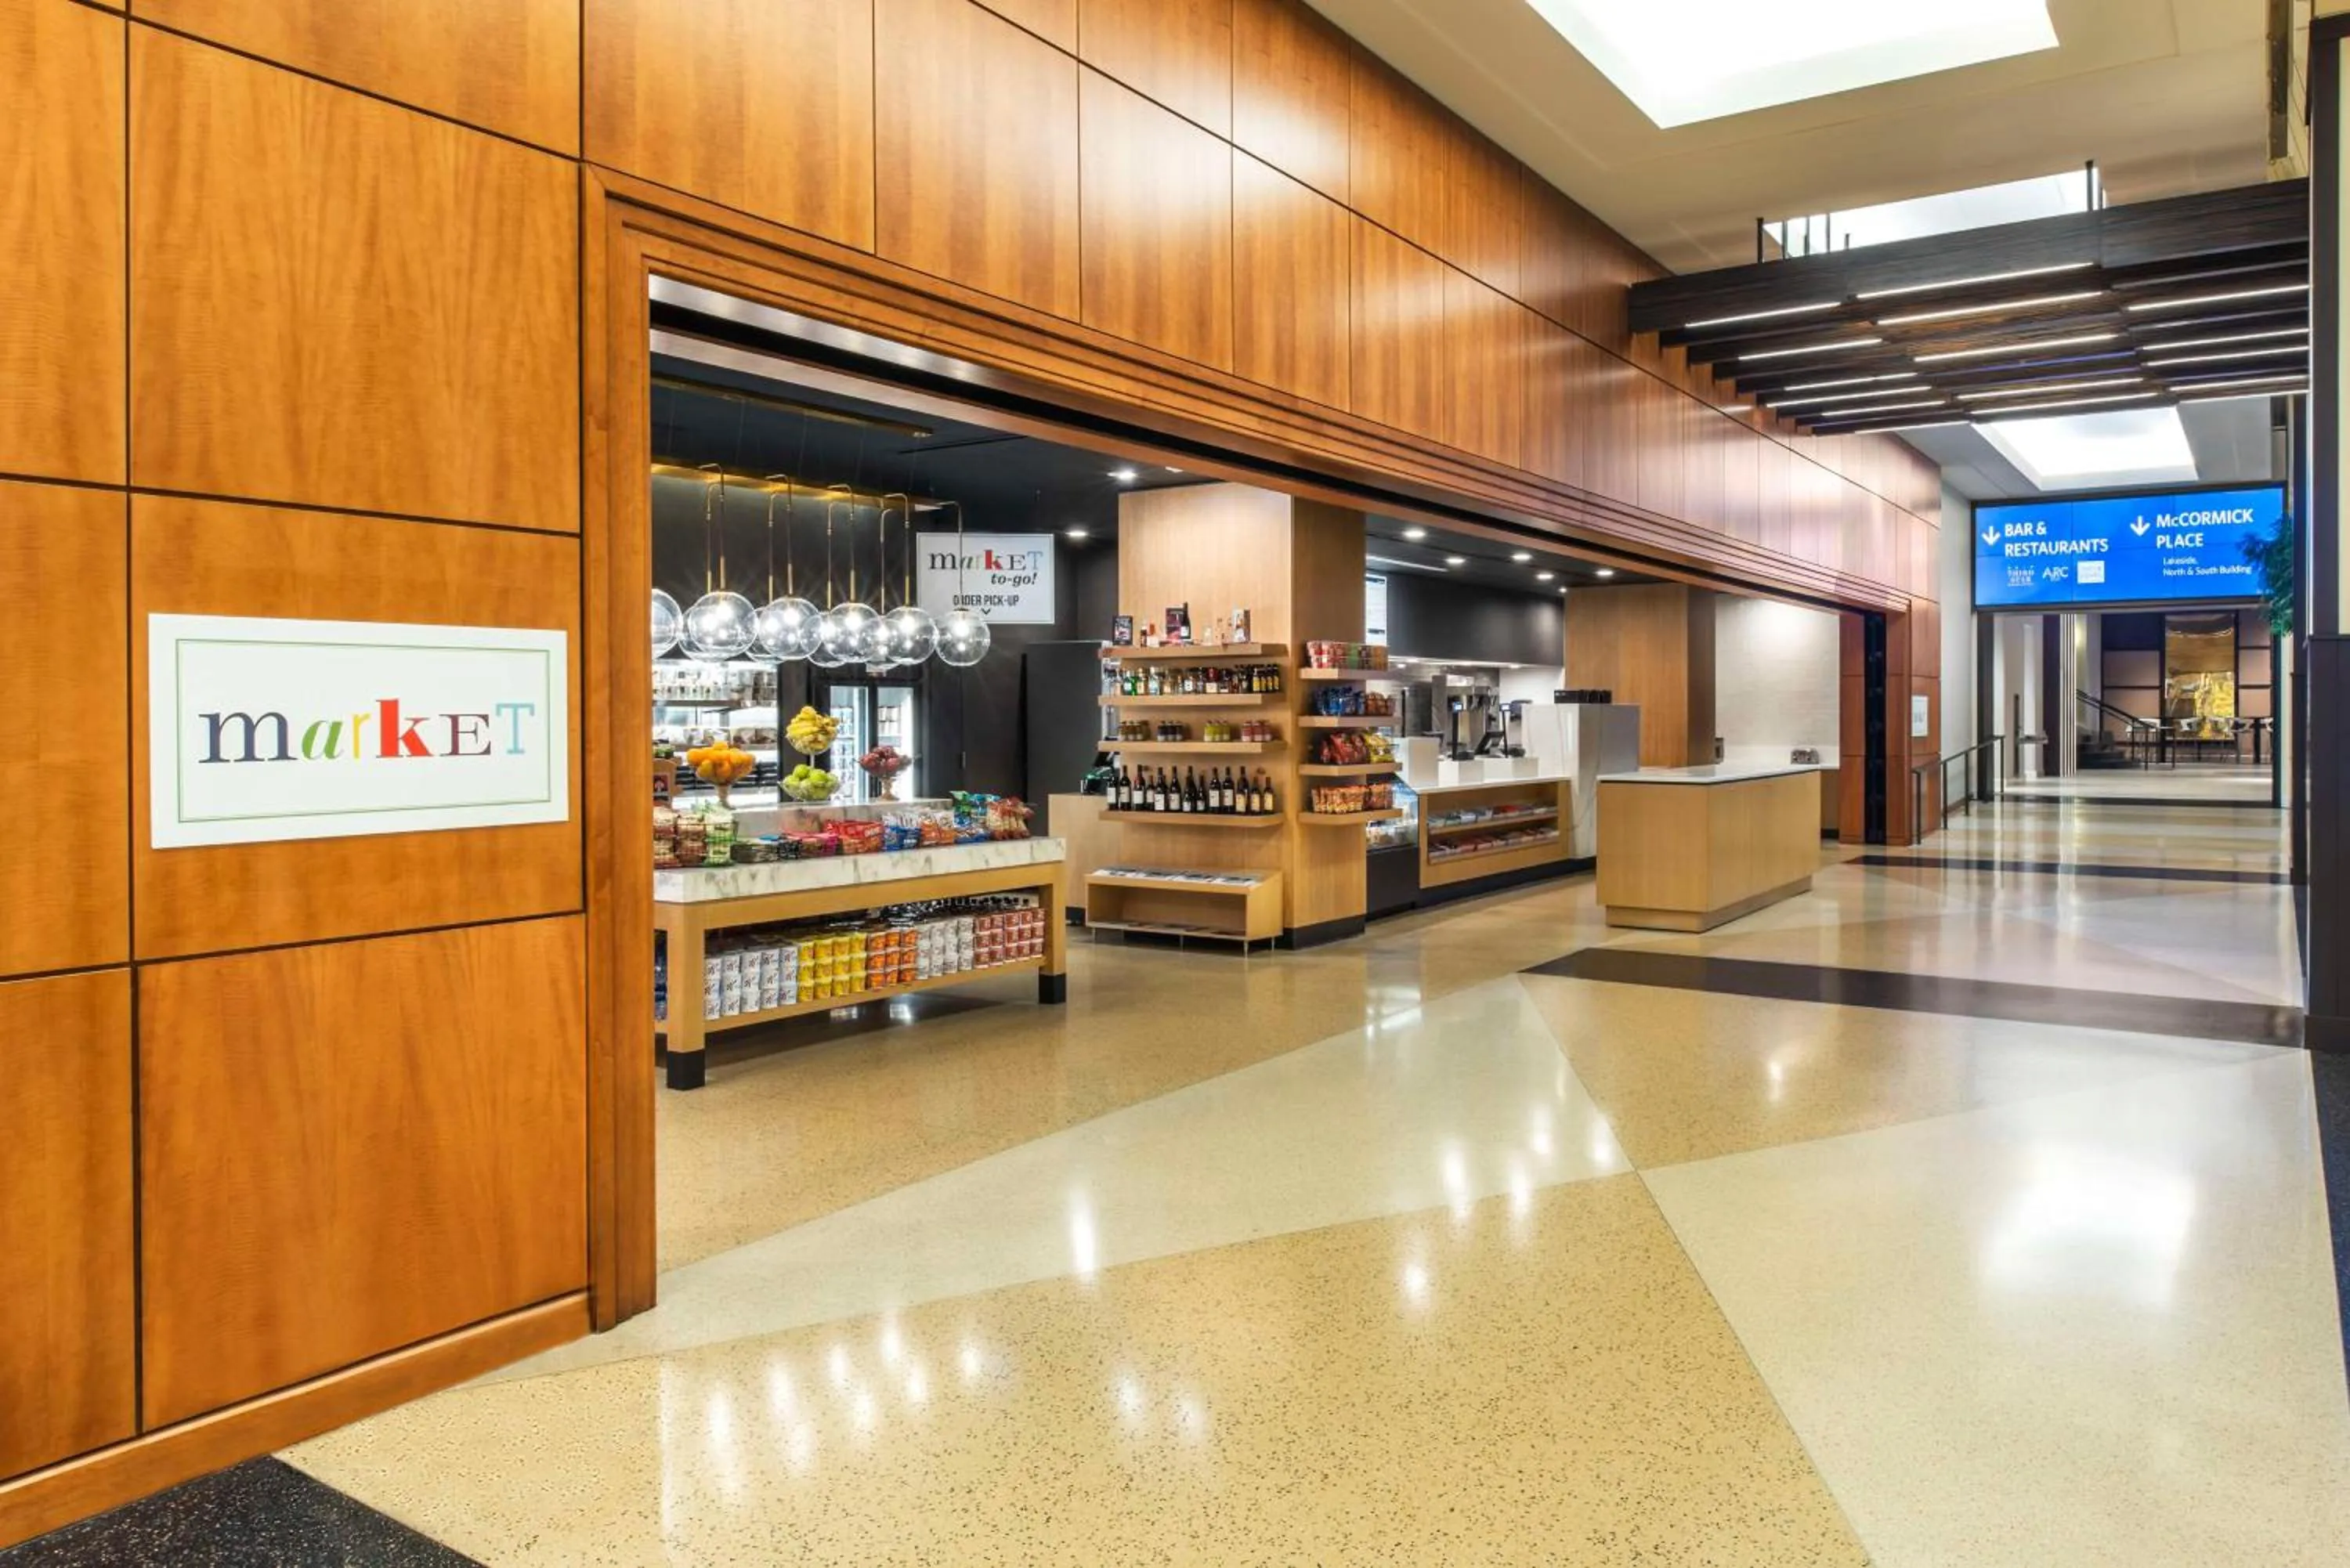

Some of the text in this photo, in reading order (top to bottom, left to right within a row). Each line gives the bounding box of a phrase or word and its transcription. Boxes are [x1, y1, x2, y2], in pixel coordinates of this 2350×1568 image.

[2156, 508, 2254, 529] McCORMICK
[2005, 521, 2047, 537] BAR &
[2005, 538, 2109, 557] RESTAURANTS
[2156, 533, 2204, 549] PLACE
[991, 573, 1037, 587] to-go!
[984, 594, 1020, 606] PICK-UP
